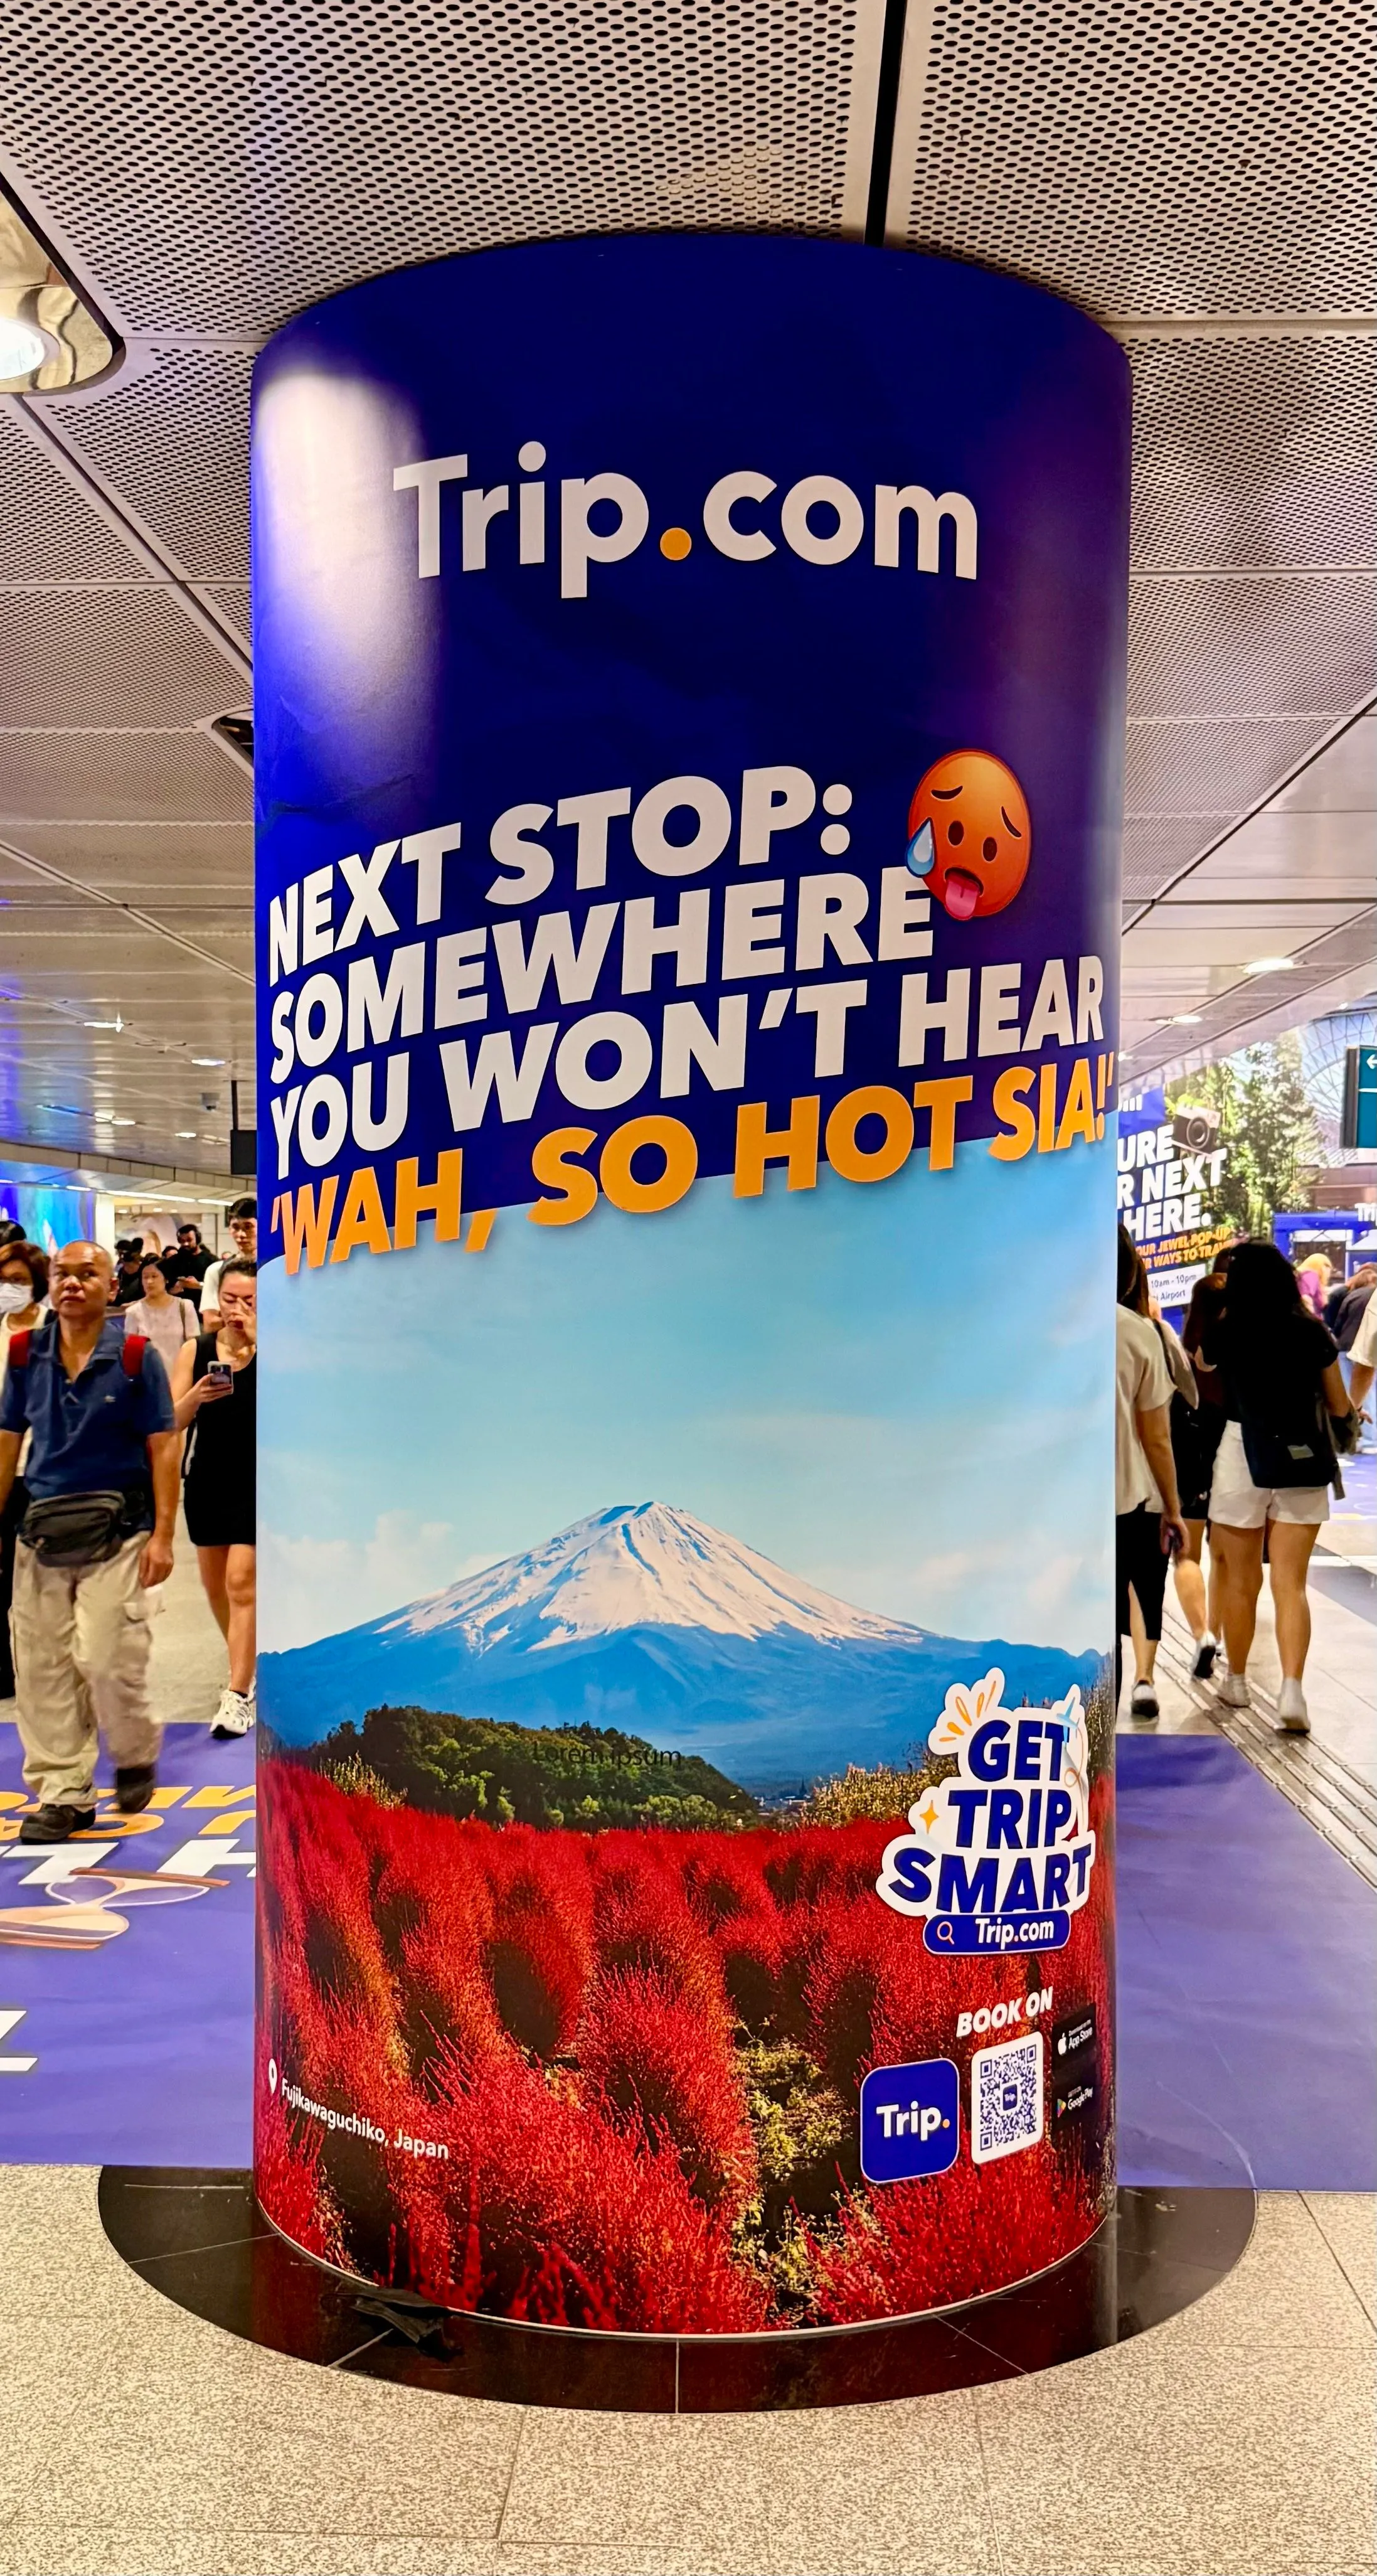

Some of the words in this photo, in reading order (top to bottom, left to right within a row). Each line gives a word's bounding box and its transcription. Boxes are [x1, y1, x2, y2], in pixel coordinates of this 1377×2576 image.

[393, 441, 977, 599] Trip.com
[269, 821, 462, 987] NEXT
[484, 766, 853, 906] STOP:
[270, 865, 934, 1084] SOMEWHERE
[270, 1051, 410, 1180] YOU
[439, 979, 868, 1132] WON'T
[898, 955, 1104, 1067] HEAR
[527, 1116, 698, 1226] SO
[733, 1076, 973, 1199] HOT
[1142, 1148, 1228, 1204] NEXT
[1124, 1193, 1212, 1241] HERE.
[1354, 1202, 1377, 1226] Tri
[968, 1719, 1070, 1783] GET
[947, 1788, 1072, 1850] TRIP
[888, 1843, 1092, 1913] SMART
[975, 1918, 1055, 1950] Trip.com
[955, 1997, 1023, 2038] BOOK
[1025, 1985, 1053, 2018] ON
[282, 2077, 389, 2147] Fujikawaguchiko,
[394, 2128, 449, 2160] Japan
[876, 2100, 950, 2142] Trip.
